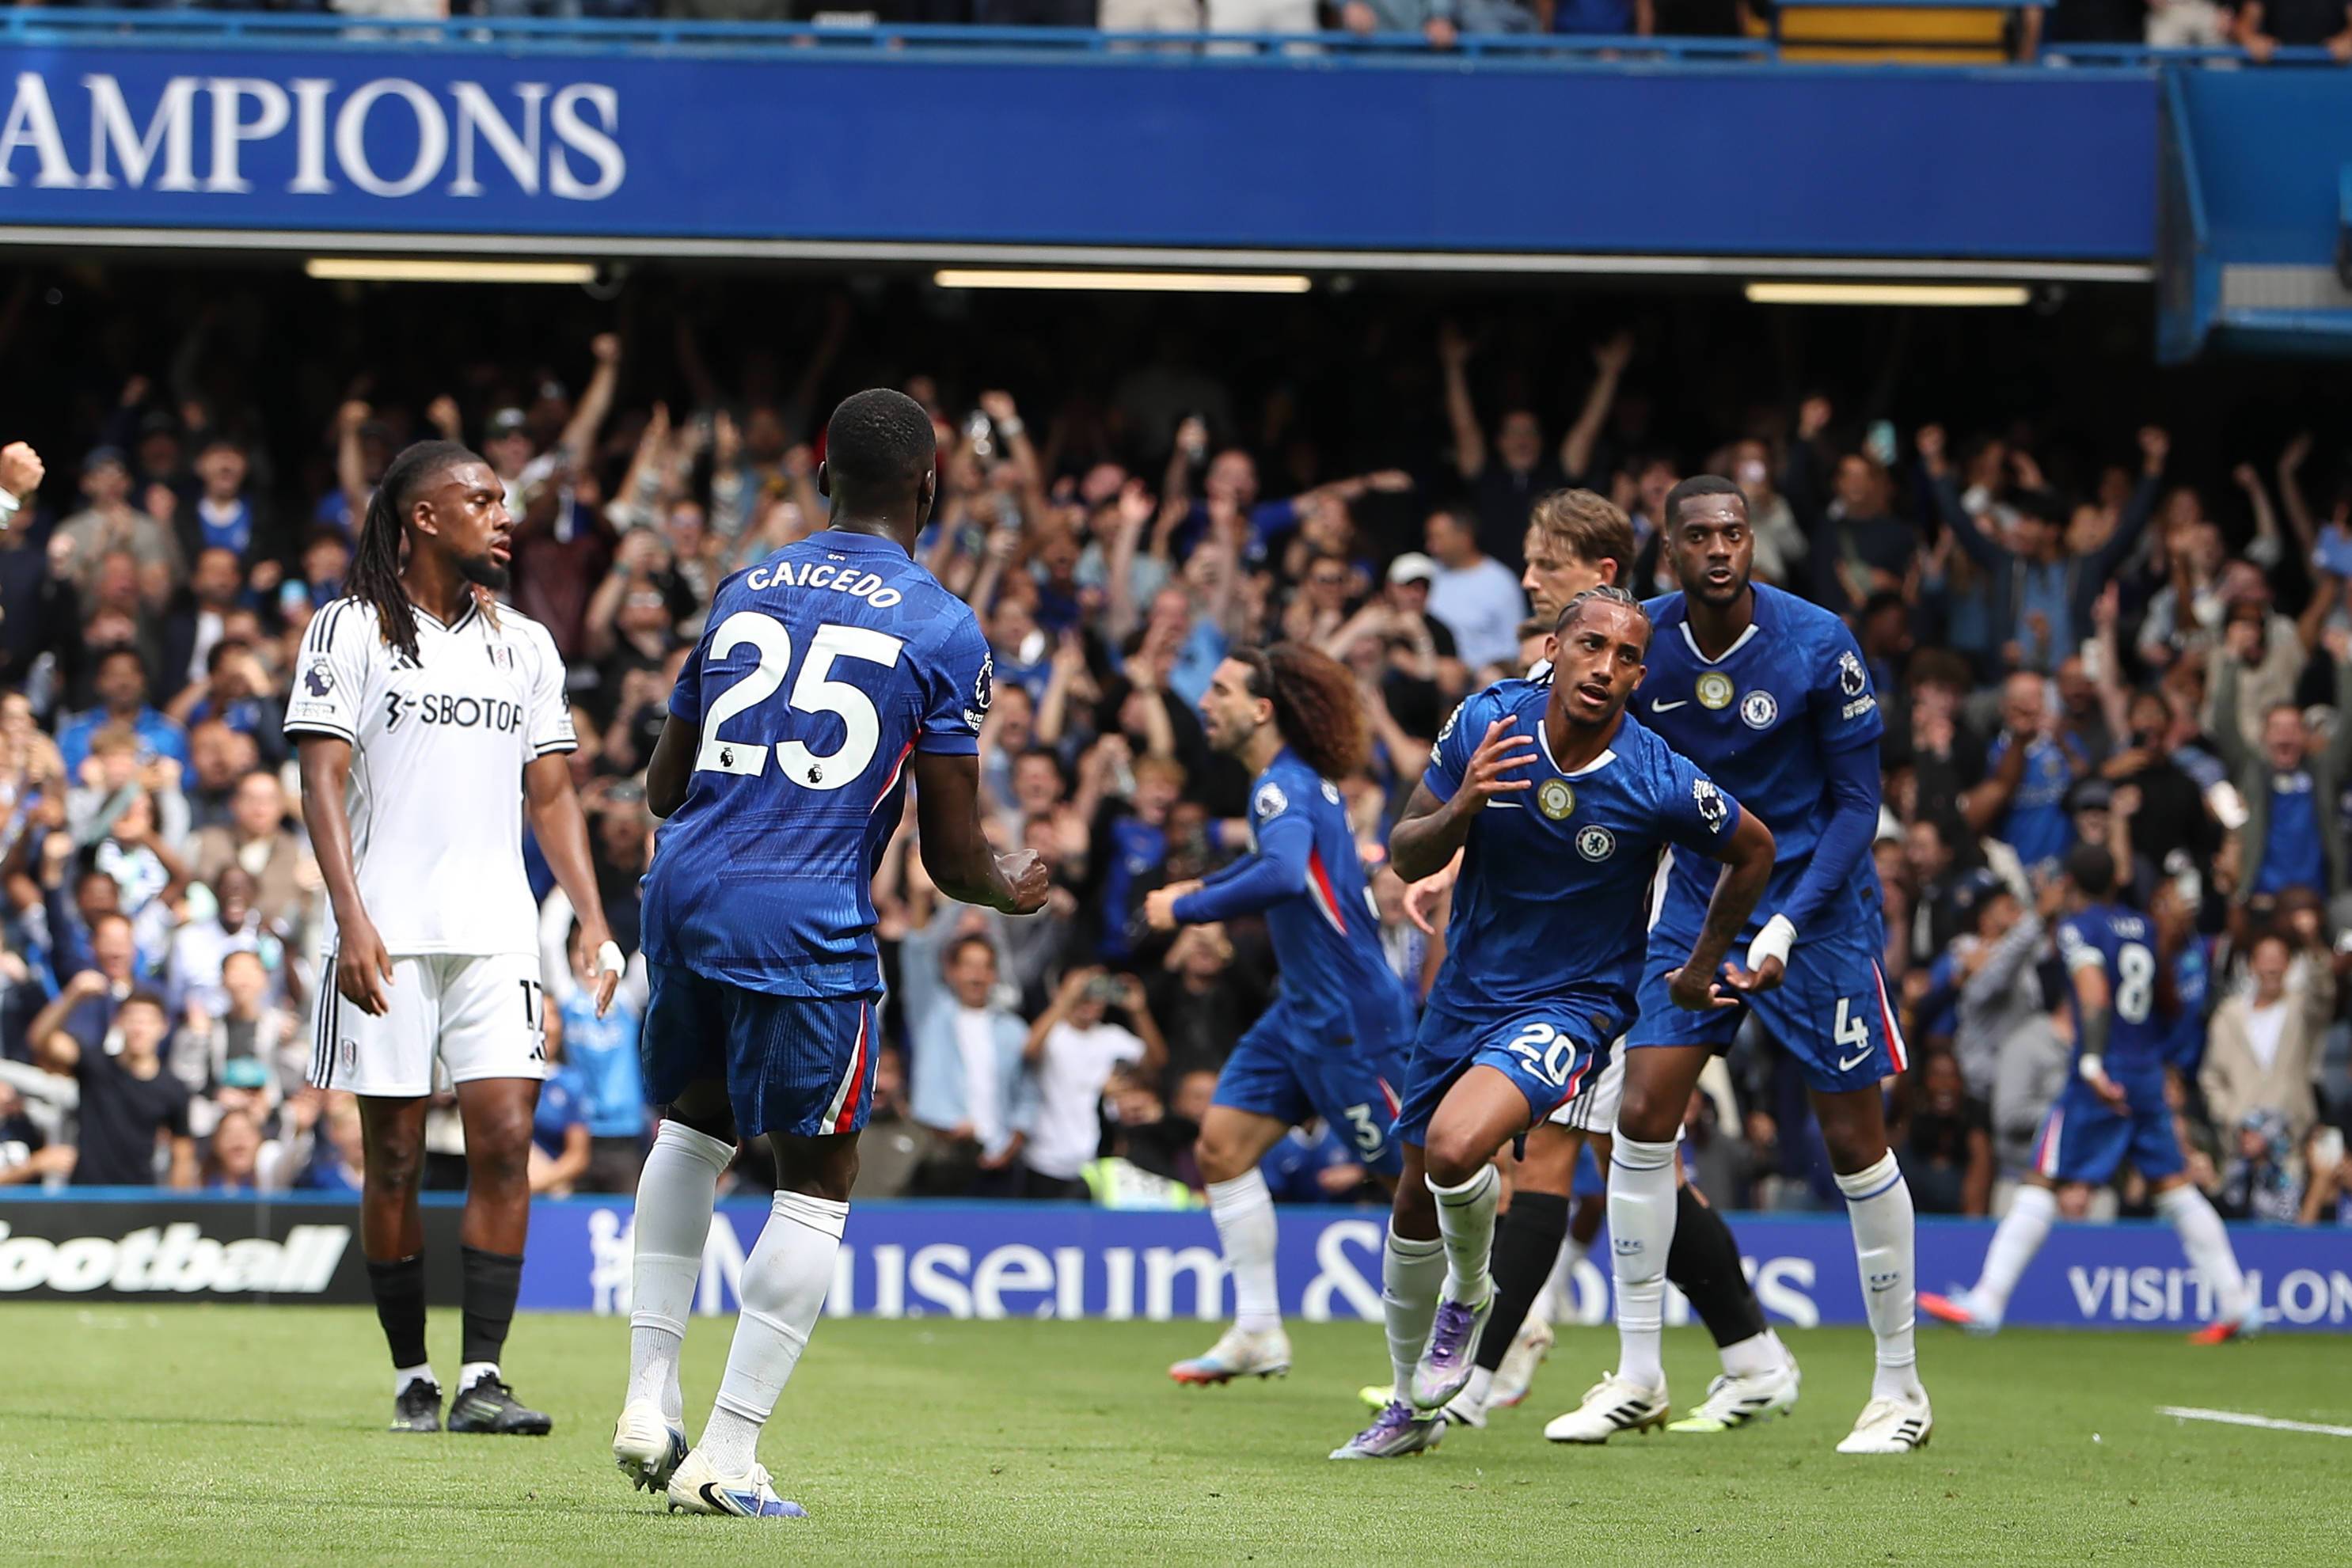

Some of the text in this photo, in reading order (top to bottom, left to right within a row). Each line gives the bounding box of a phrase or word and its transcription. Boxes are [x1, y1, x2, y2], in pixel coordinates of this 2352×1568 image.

[0, 71, 626, 200] AMPIONS
[747, 562, 902, 609] CAICEDO
[695, 611, 904, 790] 25
[2115, 940, 2156, 1025] 8
[1508, 1023, 1576, 1086] 20
[1833, 997, 1869, 1049] 4
[1344, 1102, 1382, 1151] 3
[0, 1220, 352, 1294] ootball
[1301, 1219, 1385, 1323] &
